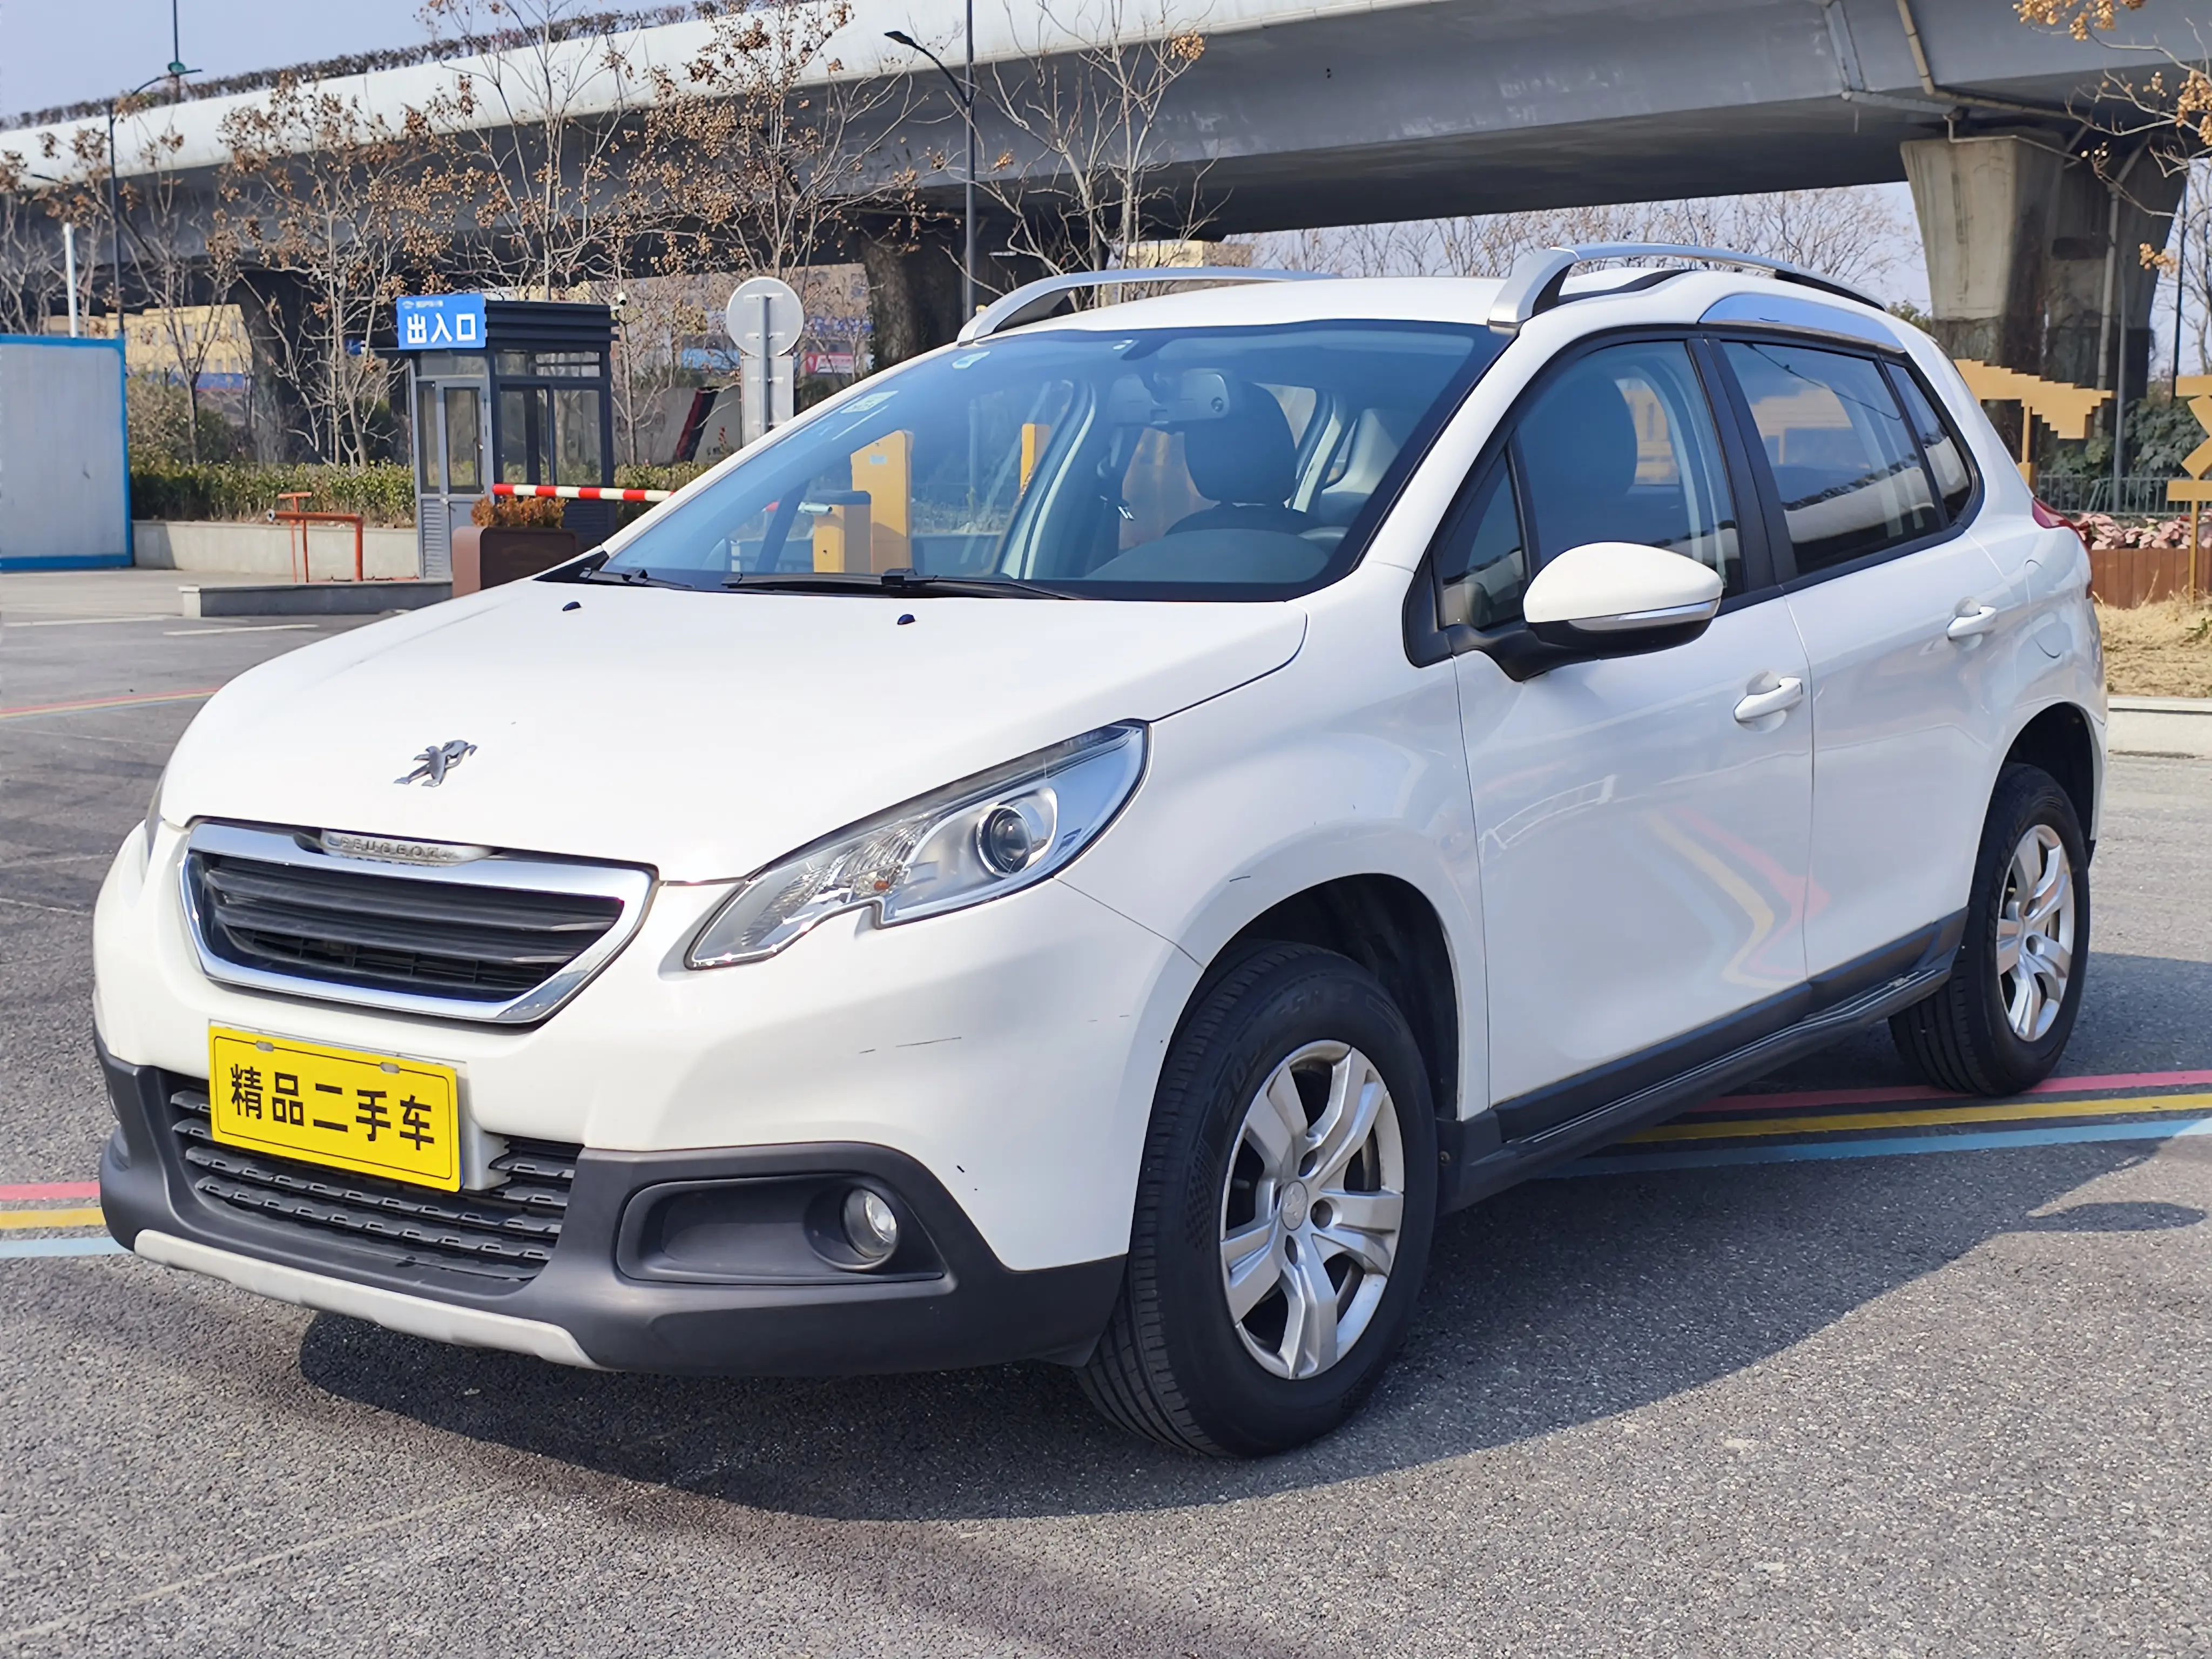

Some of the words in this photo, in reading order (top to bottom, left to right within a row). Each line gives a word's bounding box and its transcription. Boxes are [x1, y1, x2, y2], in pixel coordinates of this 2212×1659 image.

[407, 312, 476, 343] 出入口
[230, 1063, 435, 1151] 精品二手车
